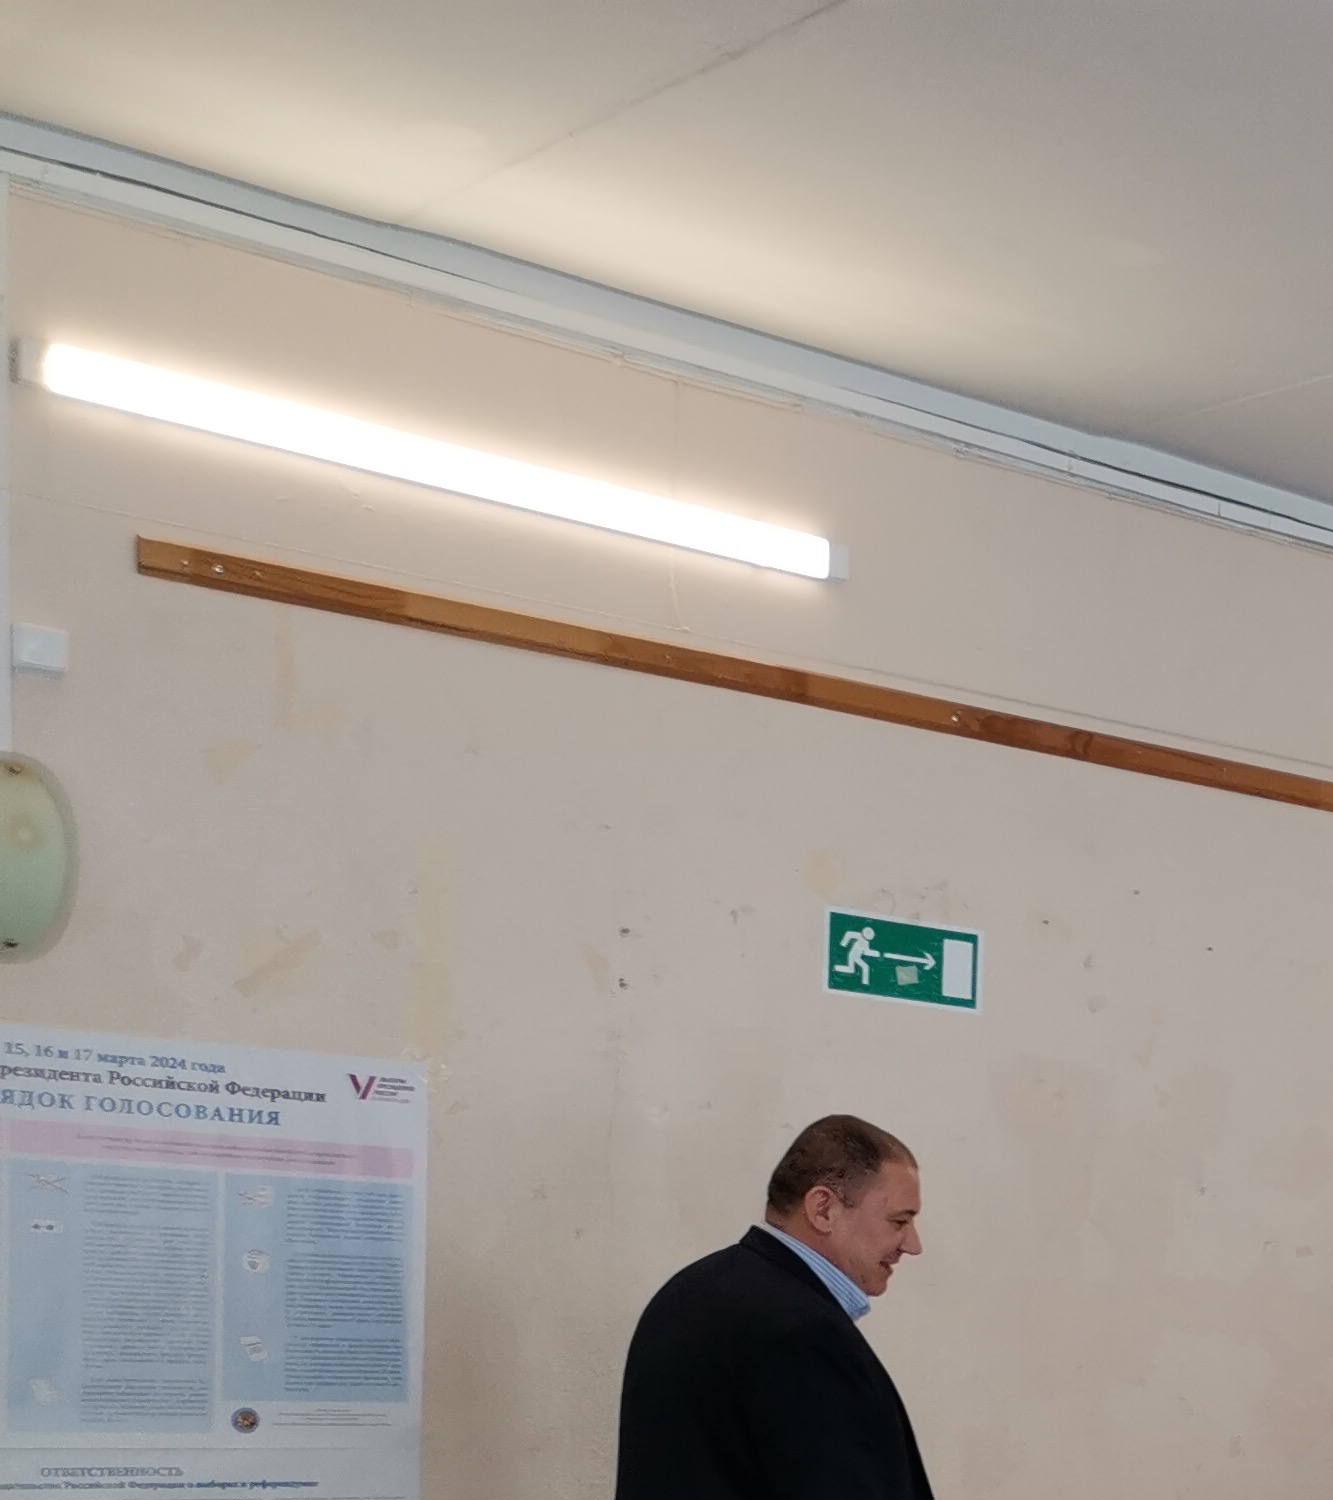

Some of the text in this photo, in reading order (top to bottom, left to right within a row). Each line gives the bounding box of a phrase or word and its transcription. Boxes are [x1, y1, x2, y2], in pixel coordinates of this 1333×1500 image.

[4, 1041, 226, 1074] 15, 16 и 17 марта 2024 года
[0, 1064, 327, 1104] резидента Российской Федерации
[84, 1095, 282, 1126] ГОЛОСОВАНИЯ
